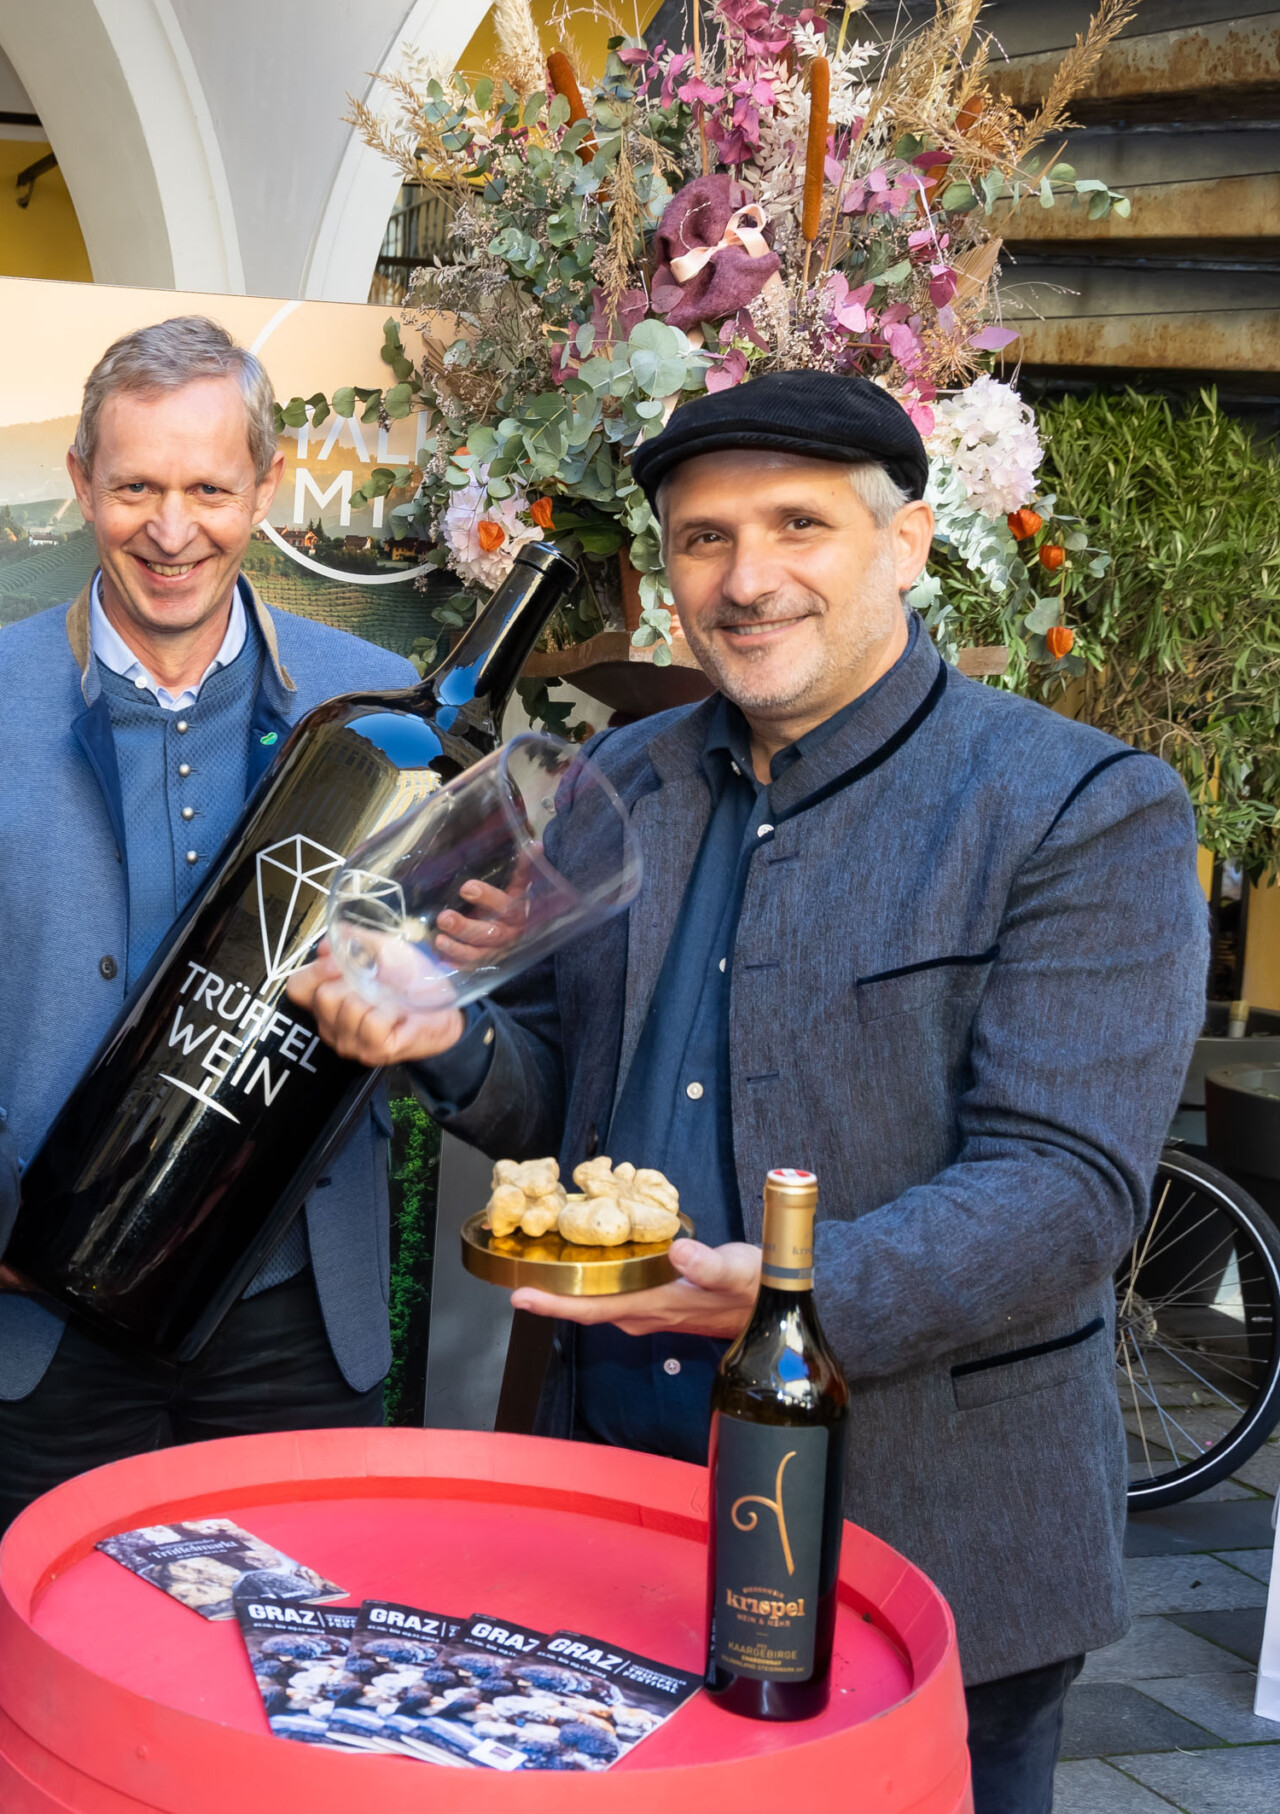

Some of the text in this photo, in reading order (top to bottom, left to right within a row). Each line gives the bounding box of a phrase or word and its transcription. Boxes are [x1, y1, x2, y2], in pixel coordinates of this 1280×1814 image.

[179, 960, 321, 1074] TRÜFFEL
[168, 1004, 291, 1107] WEIN
[247, 1603, 319, 1626] GRAZ
[725, 1588, 806, 1620] krispel
[369, 1607, 440, 1635] GRAZ
[546, 1637, 623, 1672] GRAZ
[622, 1670, 678, 1695] FESTIVAL
